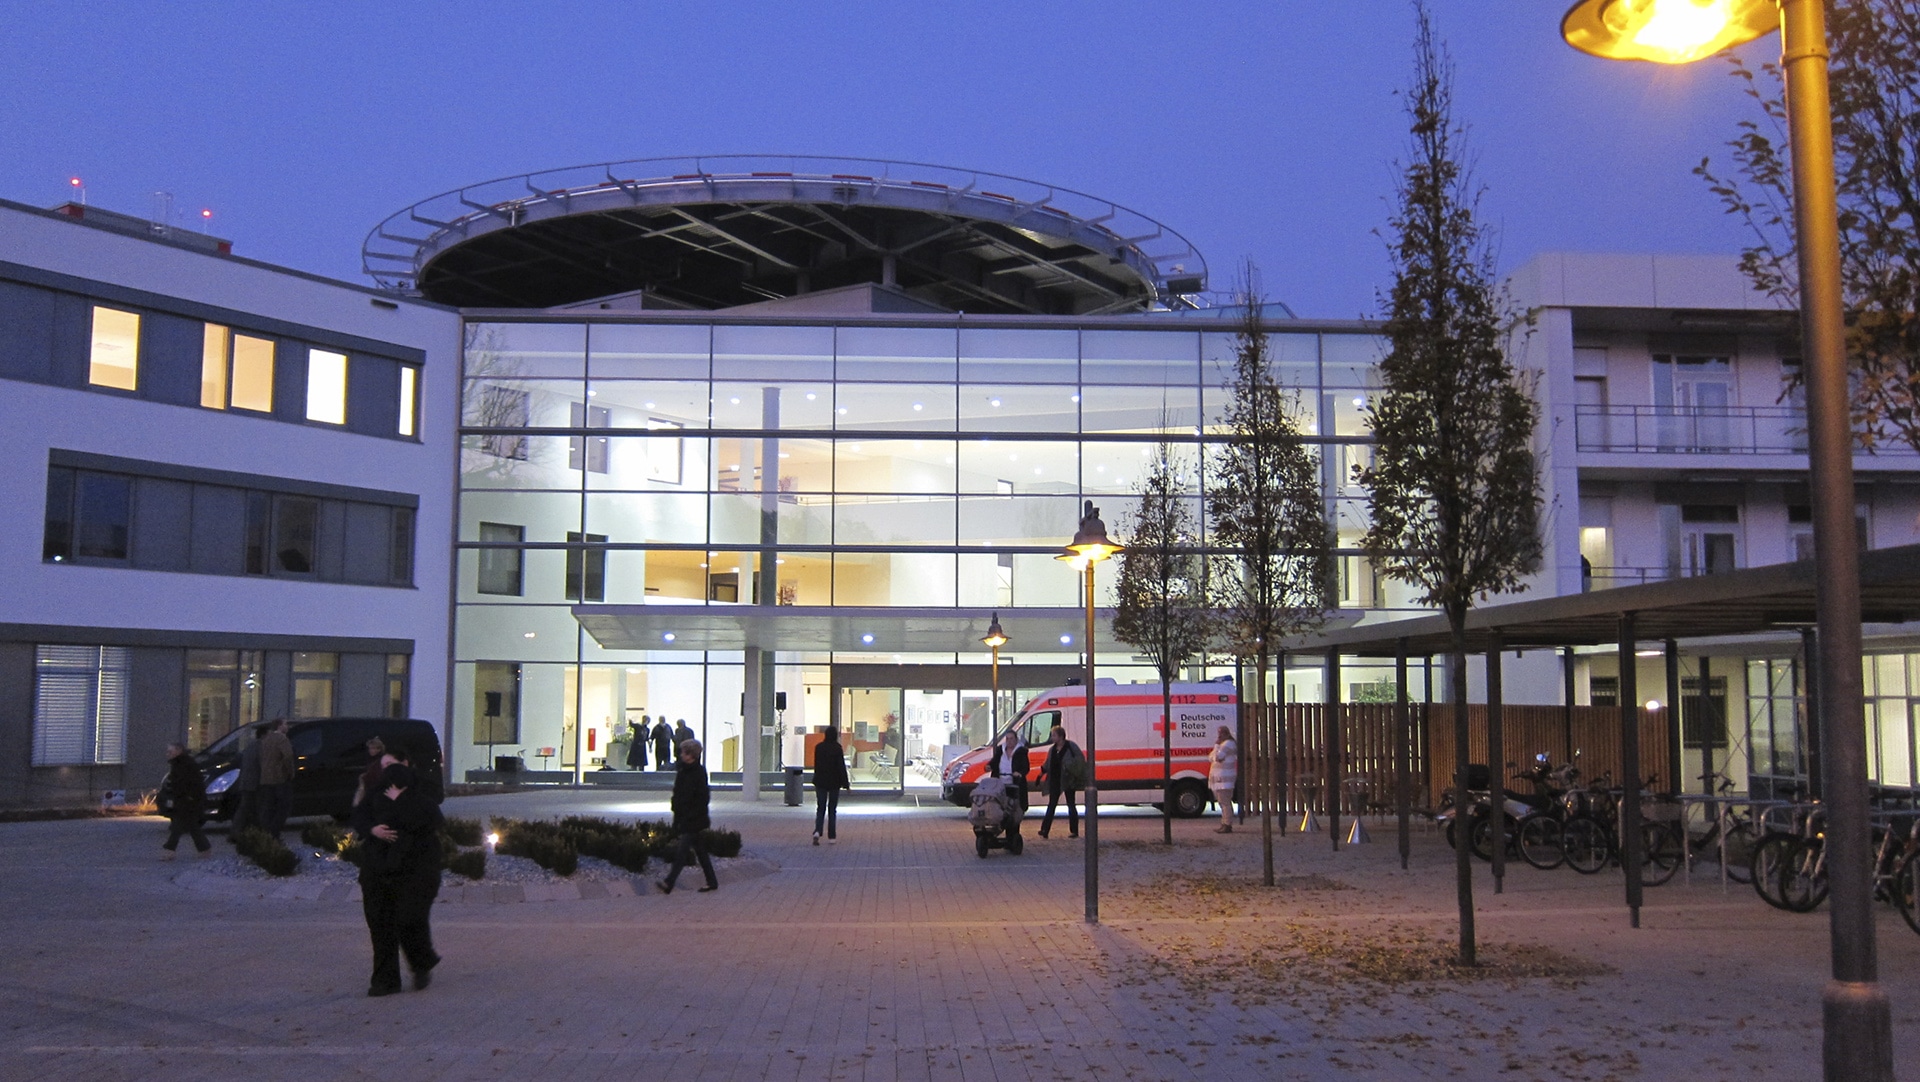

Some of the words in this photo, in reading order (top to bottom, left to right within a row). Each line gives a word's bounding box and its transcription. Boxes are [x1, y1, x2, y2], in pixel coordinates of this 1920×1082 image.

[1177, 694, 1197, 704] 112
[1180, 713, 1226, 721] Deutsches
[1181, 722, 1206, 730] Rotes
